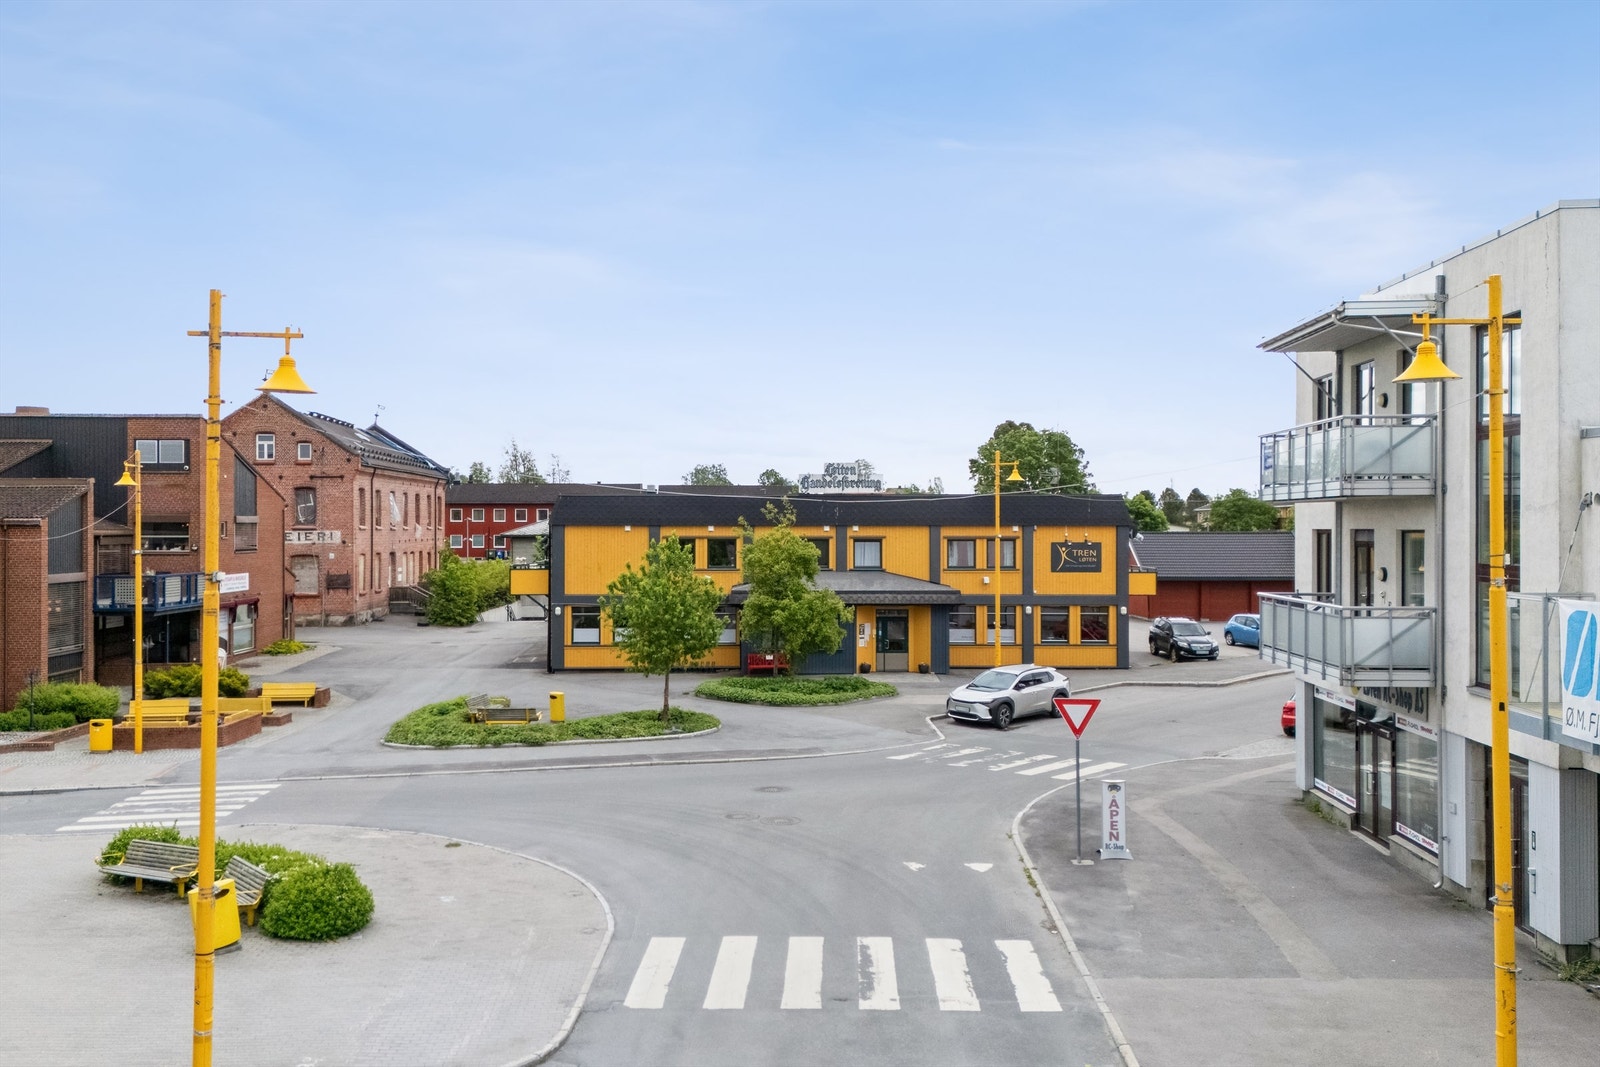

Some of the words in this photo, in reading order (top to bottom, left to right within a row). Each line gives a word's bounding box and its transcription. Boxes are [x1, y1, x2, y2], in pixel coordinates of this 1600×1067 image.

[1566, 707, 1586, 731] Ø.M.
[1108, 794, 1120, 842] ÅPEN
[1104, 842, 1125, 852] RC-Shop
